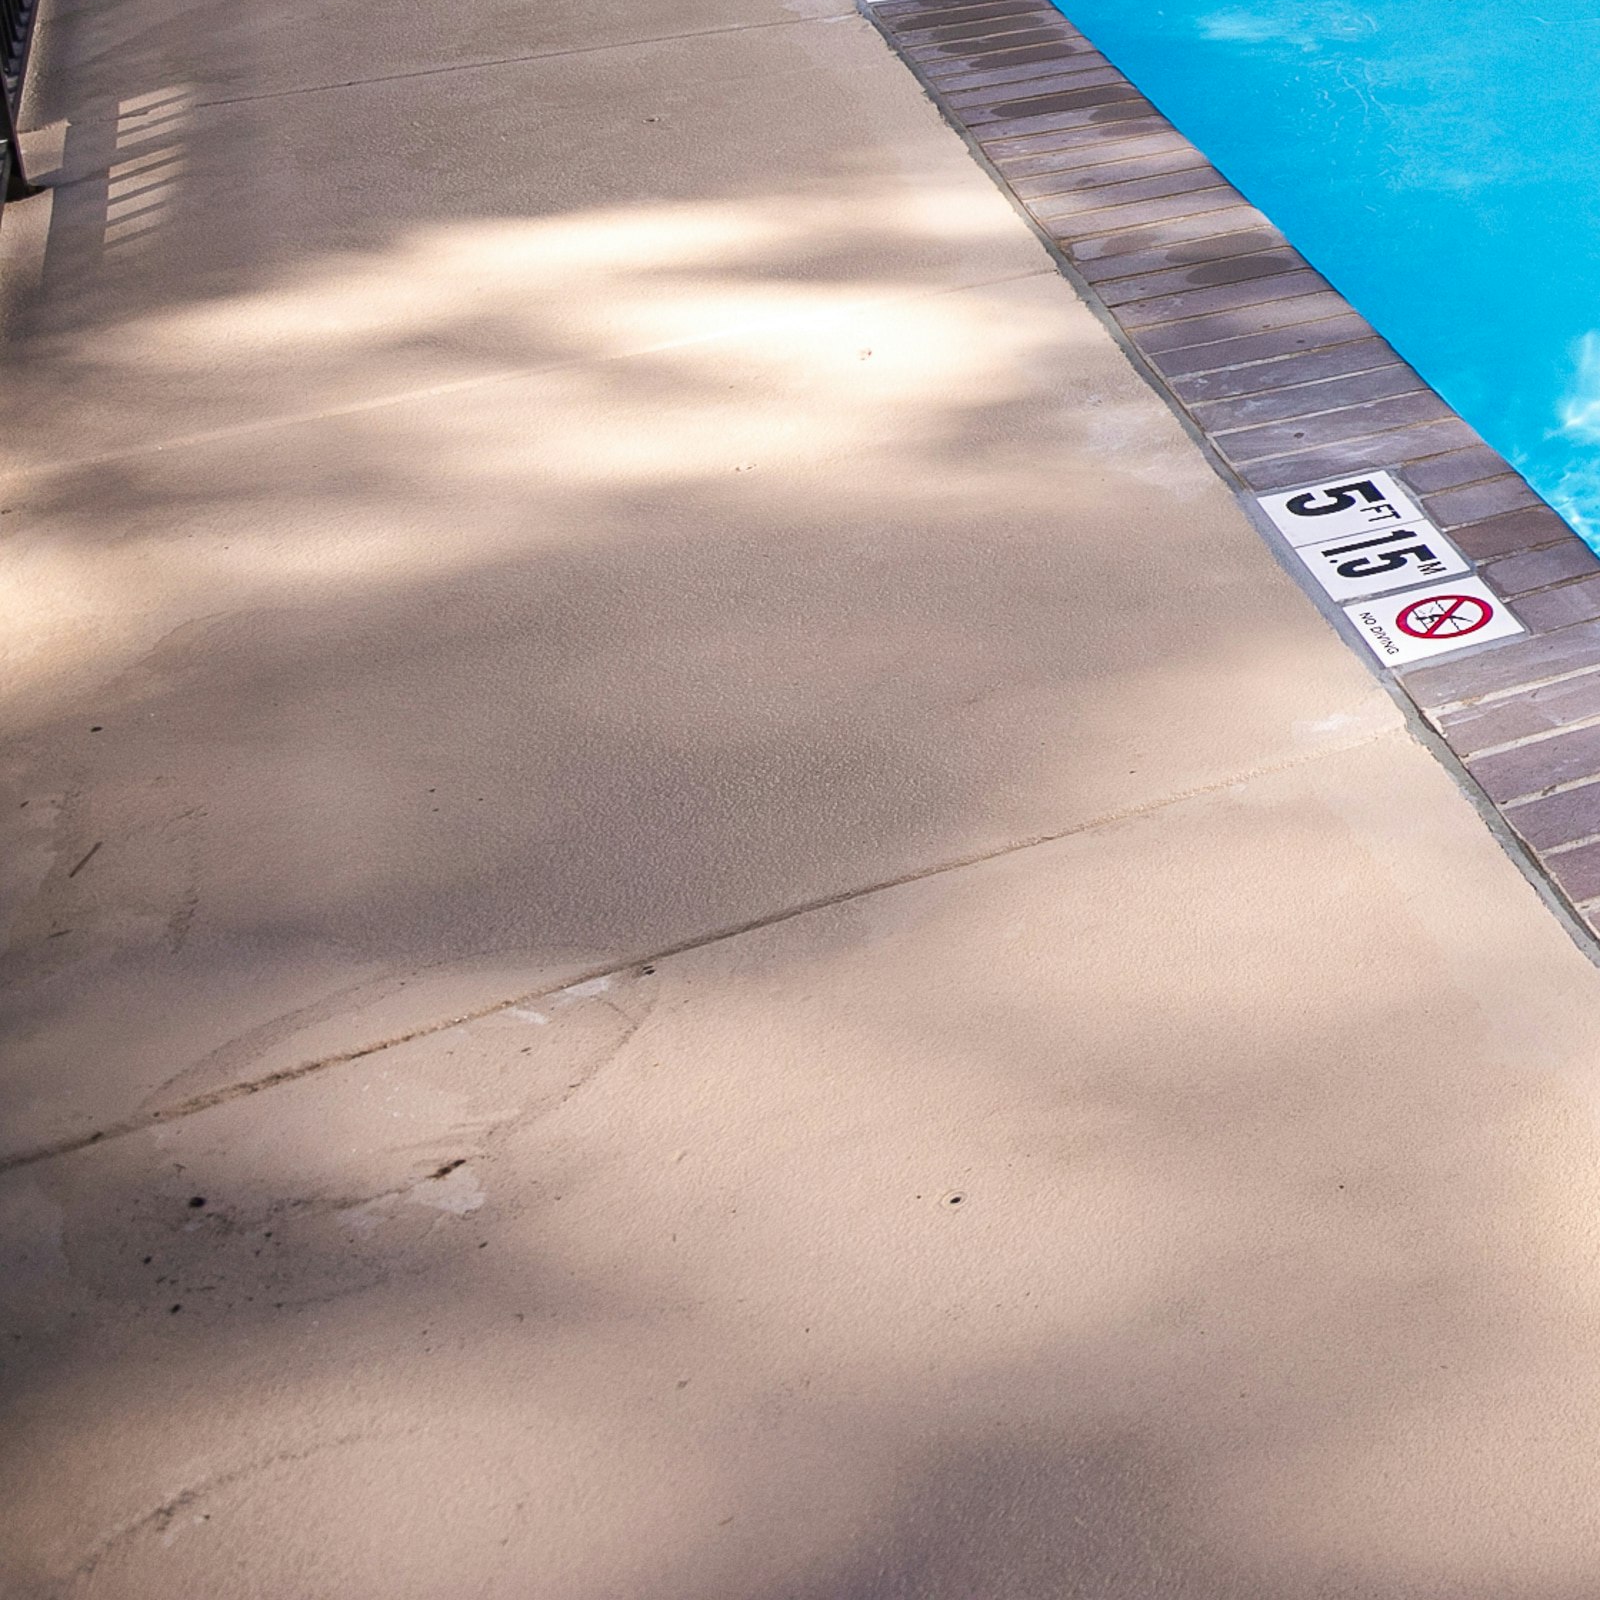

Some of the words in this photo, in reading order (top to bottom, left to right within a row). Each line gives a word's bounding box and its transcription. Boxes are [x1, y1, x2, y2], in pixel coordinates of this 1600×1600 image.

[1286, 480, 1386, 517] 5
[1360, 504, 1402, 522] FT
[1321, 529, 1437, 578] 1.5
[1417, 561, 1448, 577] M
[1360, 612, 1377, 625] NO
[1370, 626, 1399, 655] DIVING
